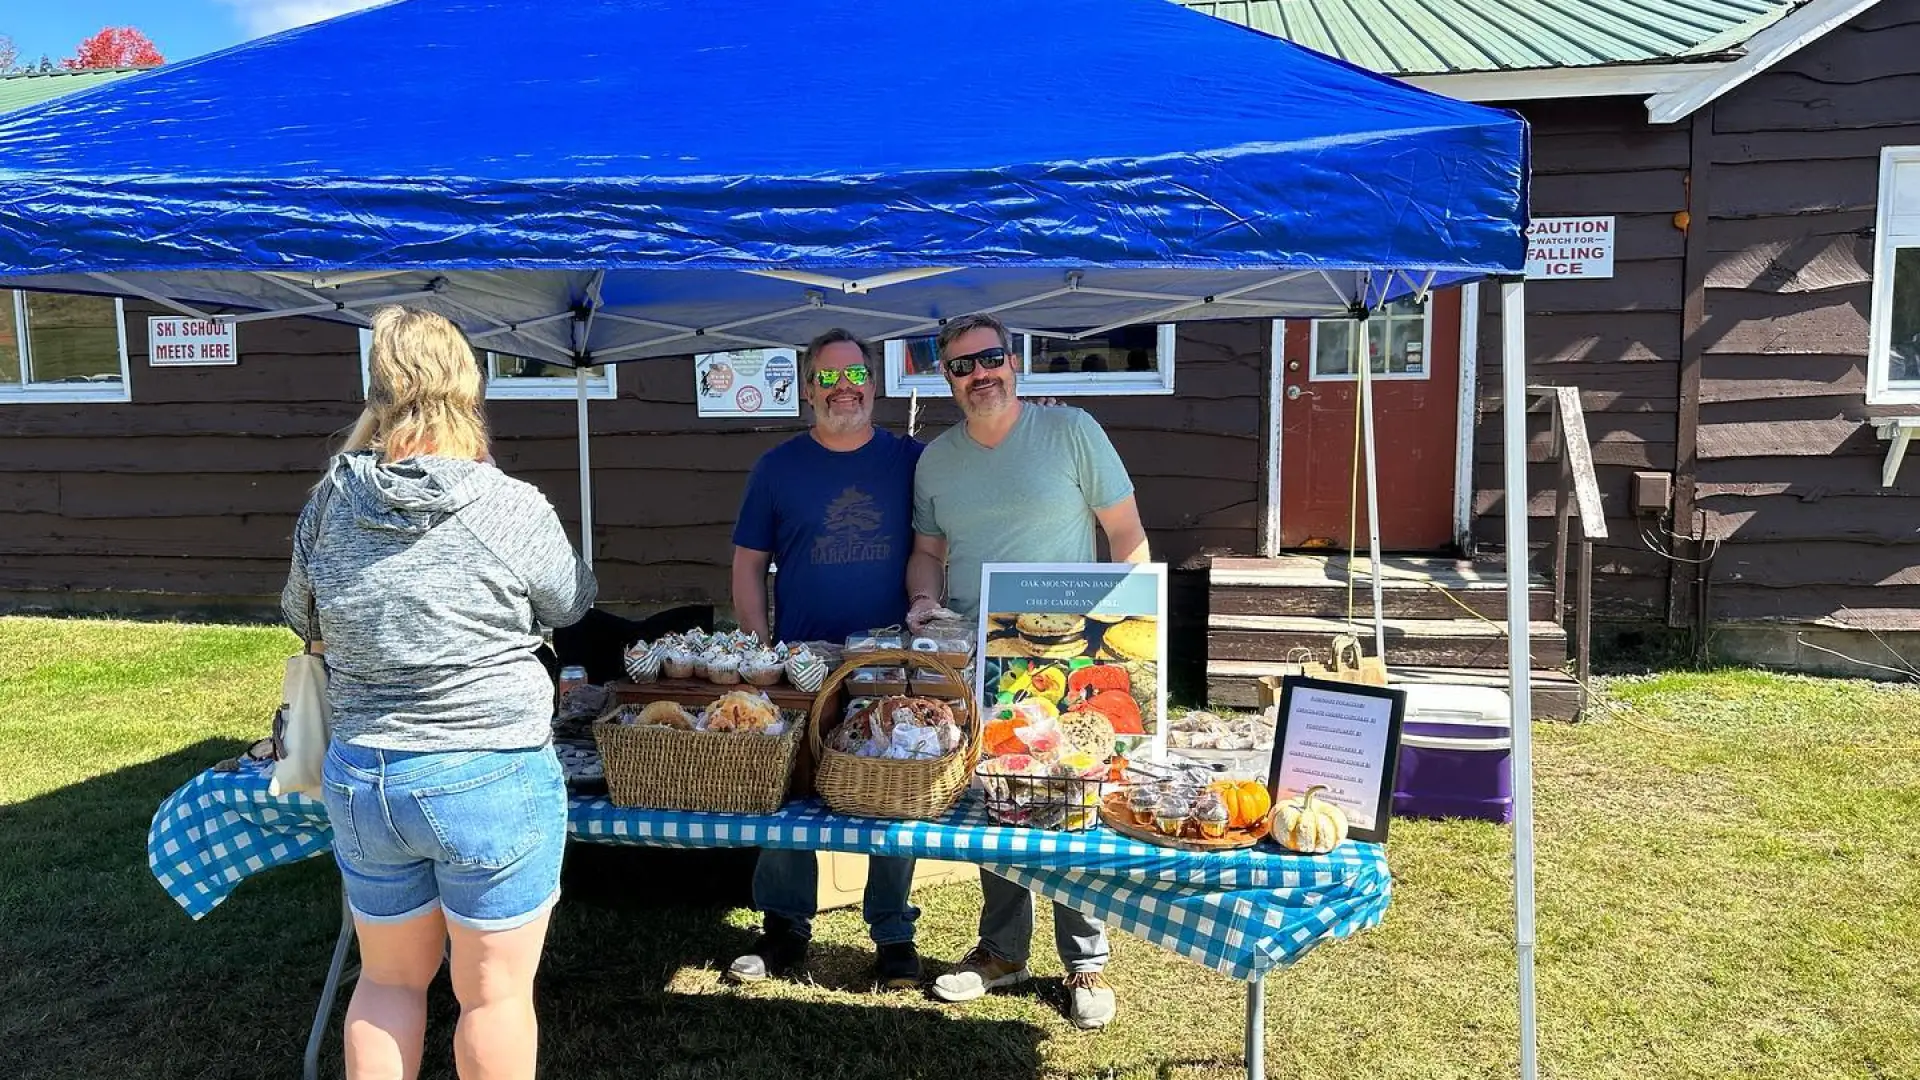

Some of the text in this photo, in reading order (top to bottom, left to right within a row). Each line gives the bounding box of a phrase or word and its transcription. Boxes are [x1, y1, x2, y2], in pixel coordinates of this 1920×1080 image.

[1525, 221, 1608, 234] CAUTION
[1528, 248, 1604, 260] FALLING
[1546, 263, 1583, 275] ICE
[156, 322, 228, 336] SKI SCHOOL
[156, 344, 230, 360] MEETS HERE
[1020, 580, 1040, 588] OAK
[1040, 580, 1090, 588] MOUNTAIN
